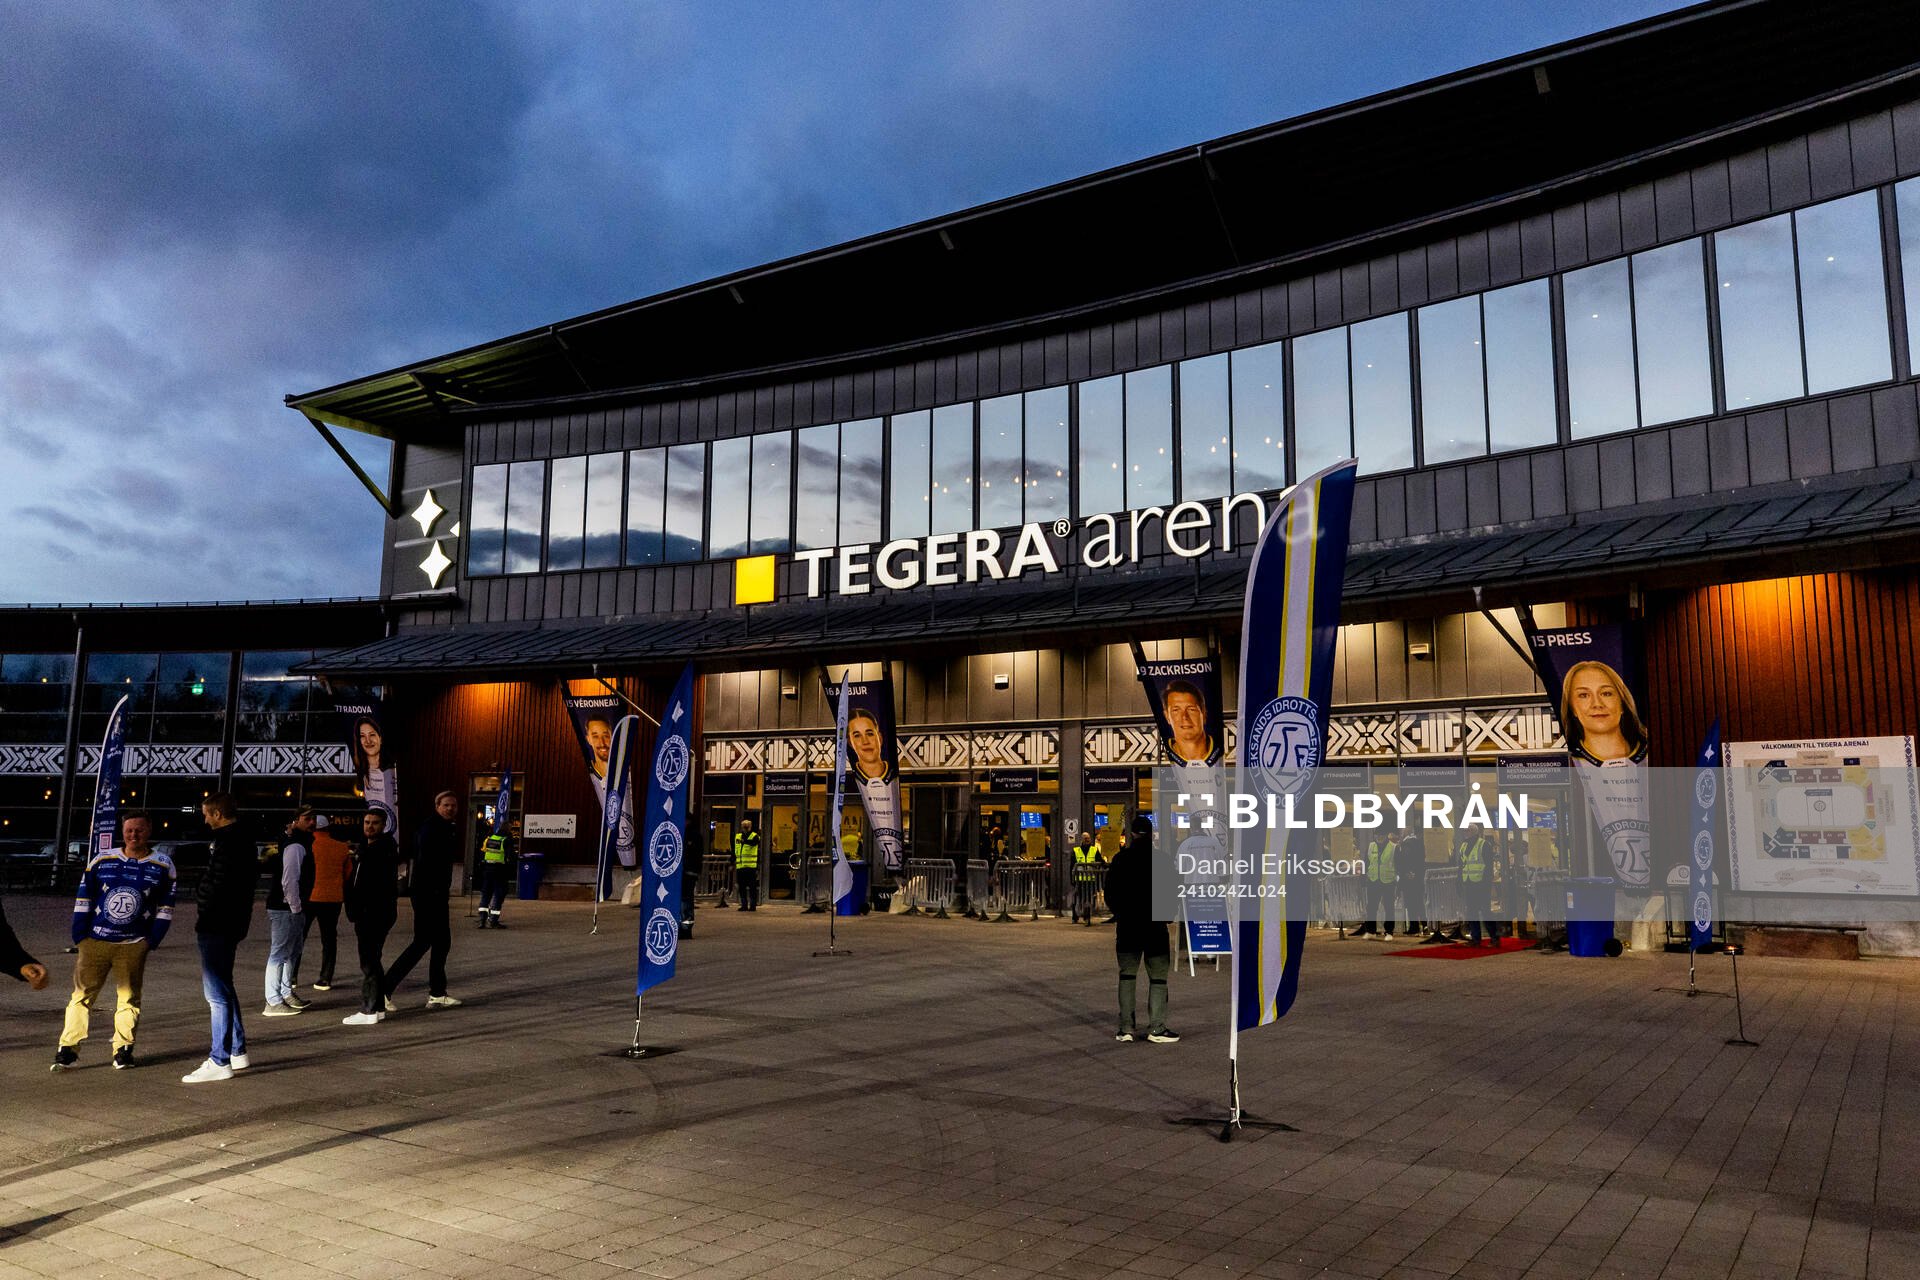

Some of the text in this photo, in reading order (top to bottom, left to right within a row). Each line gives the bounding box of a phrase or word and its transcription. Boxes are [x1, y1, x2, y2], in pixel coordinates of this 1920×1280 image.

[1531, 632, 1592, 647] 15 PRESS
[1148, 662, 1213, 676] ZACKRISSON
[825, 686, 868, 696] 16 ABJUR
[574, 697, 619, 708] VÉRONNEAU
[1250, 709, 1273, 777] LEKSANDS
[1761, 742, 1802, 750] VÄLKOMMEN
[528, 827, 545, 836] puck
[1068, 822, 1074, 831] 4
